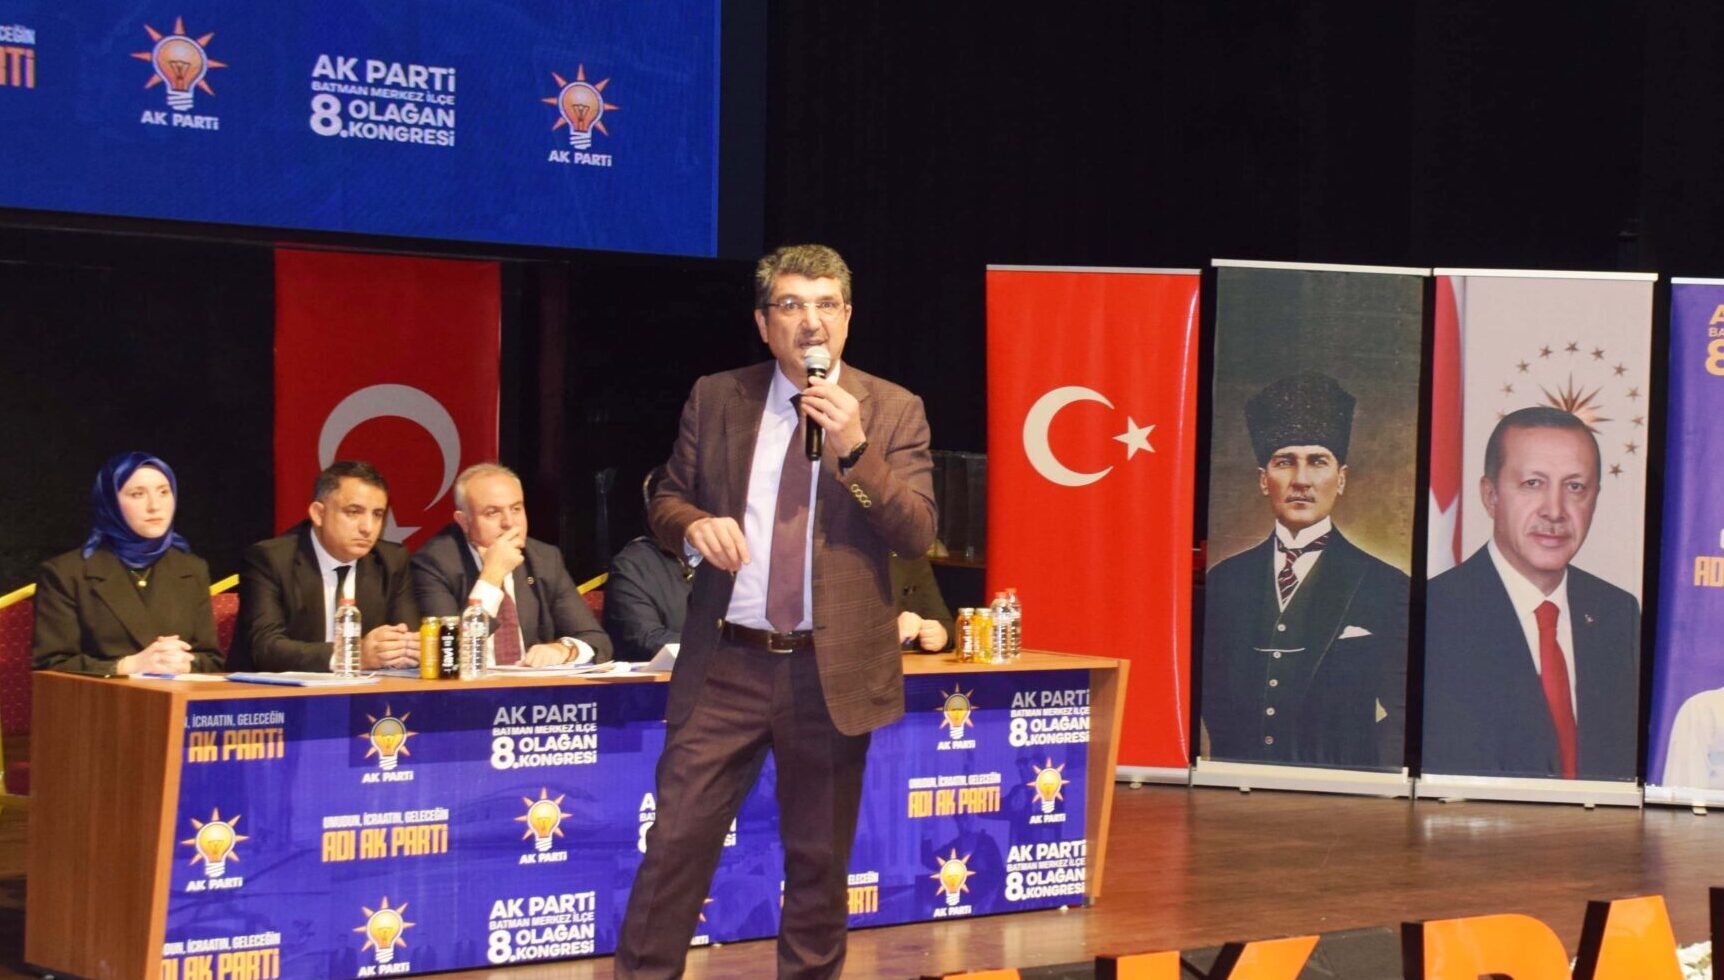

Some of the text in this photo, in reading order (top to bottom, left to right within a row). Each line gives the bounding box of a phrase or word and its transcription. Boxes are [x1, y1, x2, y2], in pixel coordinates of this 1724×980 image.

[312, 54, 359, 82] AK
[311, 80, 368, 96] BATMAN
[370, 86, 424, 102] MERKEZ
[140, 110, 168, 126] AK
[348, 99, 455, 128] OLAĞAN
[548, 150, 570, 163] AK
[1694, 556, 1724, 586] AD
[1011, 691, 1037, 708] AK
[493, 706, 527, 725] AK
[1030, 716, 1090, 732] OLAĞAN
[492, 726, 533, 737] BATMAN
[534, 724, 574, 734] MERKEZ
[188, 731, 219, 763] AK
[519, 733, 597, 752] OLAĞAN
[361, 772, 380, 783] AK
[935, 789, 955, 816] AK
[322, 829, 356, 863] ADI
[360, 827, 387, 859] AK
[1007, 844, 1034, 863] AK
[519, 854, 537, 865] AK
[185, 879, 205, 892] AK
[1026, 867, 1086, 886] OLAĞAN
[489, 898, 524, 920] AK
[489, 918, 530, 930] BATMAN
[531, 914, 571, 926] MERKEZ
[515, 923, 595, 945] OLAĞAN
[161, 957, 179, 980] DI
[358, 966, 376, 977] AK
